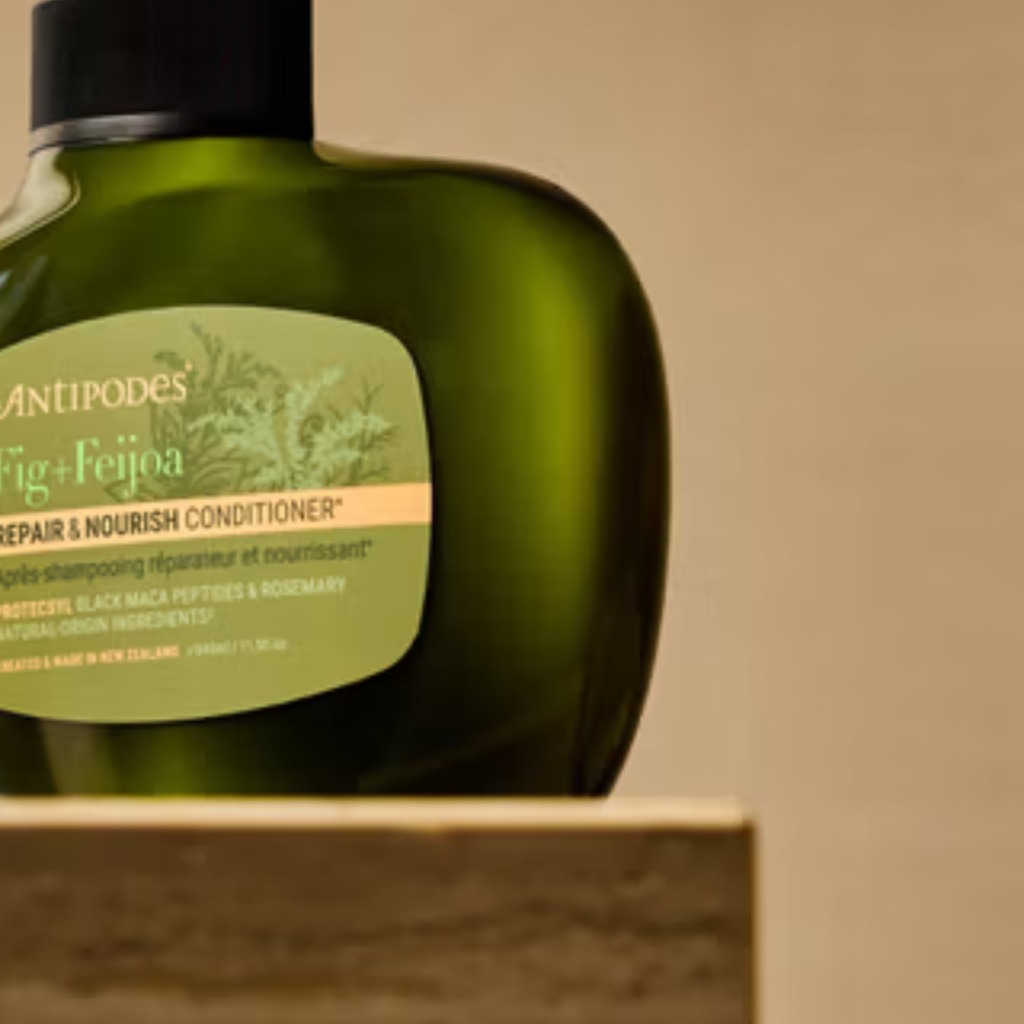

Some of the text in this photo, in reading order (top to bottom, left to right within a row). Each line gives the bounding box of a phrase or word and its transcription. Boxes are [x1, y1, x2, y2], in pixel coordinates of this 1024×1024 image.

[68, 517, 80, 541] &
[85, 509, 179, 539] NOURISH
[242, 545, 260, 566] et
[76, 591, 123, 613] BLACK
[125, 586, 168, 608] MACA
[261, 575, 348, 599] ROSEMARY
